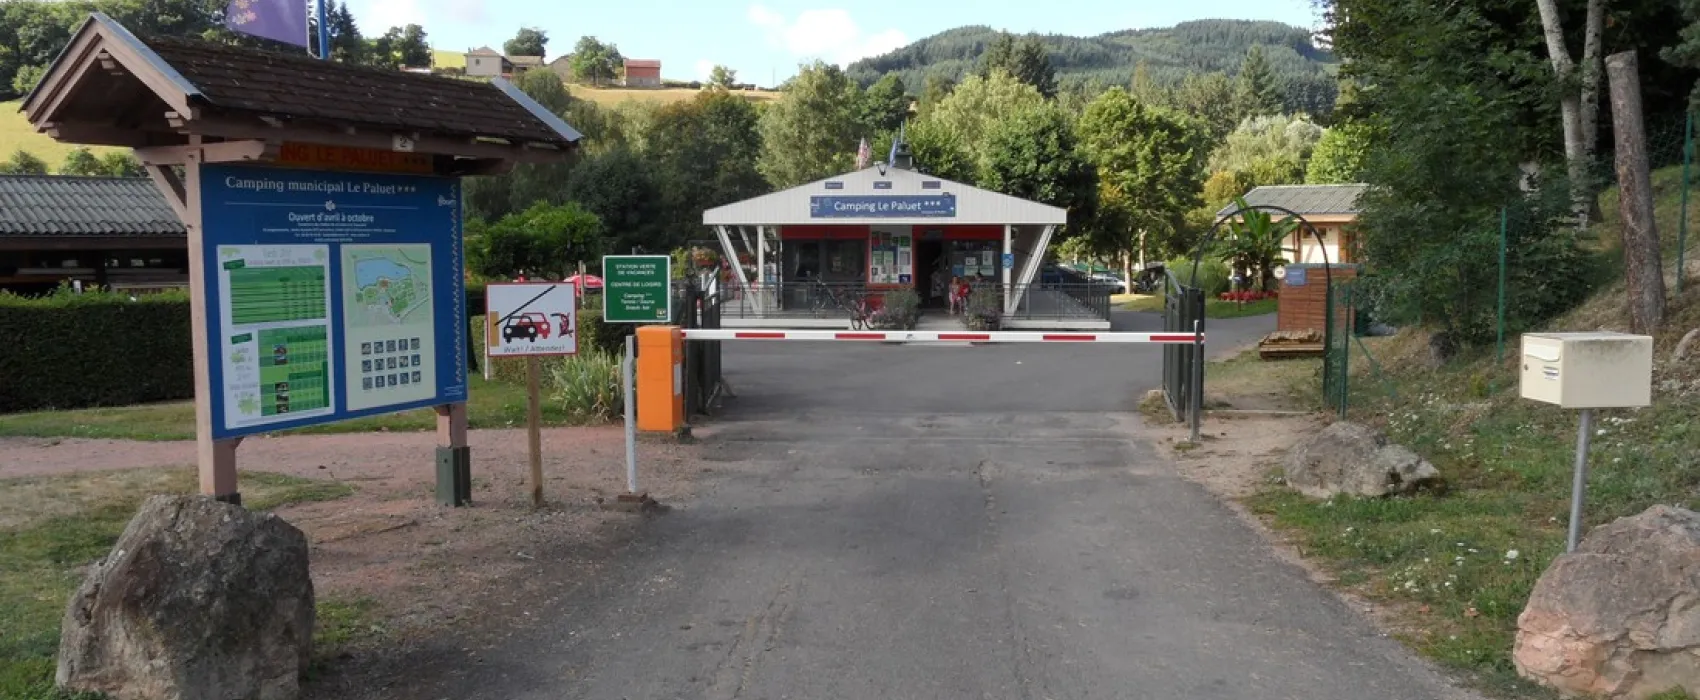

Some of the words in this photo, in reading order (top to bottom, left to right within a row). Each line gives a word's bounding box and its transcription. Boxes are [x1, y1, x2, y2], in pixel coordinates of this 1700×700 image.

[316, 146, 337, 163] LE
[225, 176, 284, 192] Camping
[288, 180, 344, 194] municipal
[347, 182, 360, 193] Le
[363, 183, 396, 195] Paluet
[834, 201, 876, 212] Camping
[878, 201, 889, 210] Le
[891, 201, 922, 211] Paluet
[288, 212, 315, 222] Ouvert
[317, 212, 340, 222] d'avril
[341, 212, 346, 222] à
[347, 212, 374, 222] octobre
